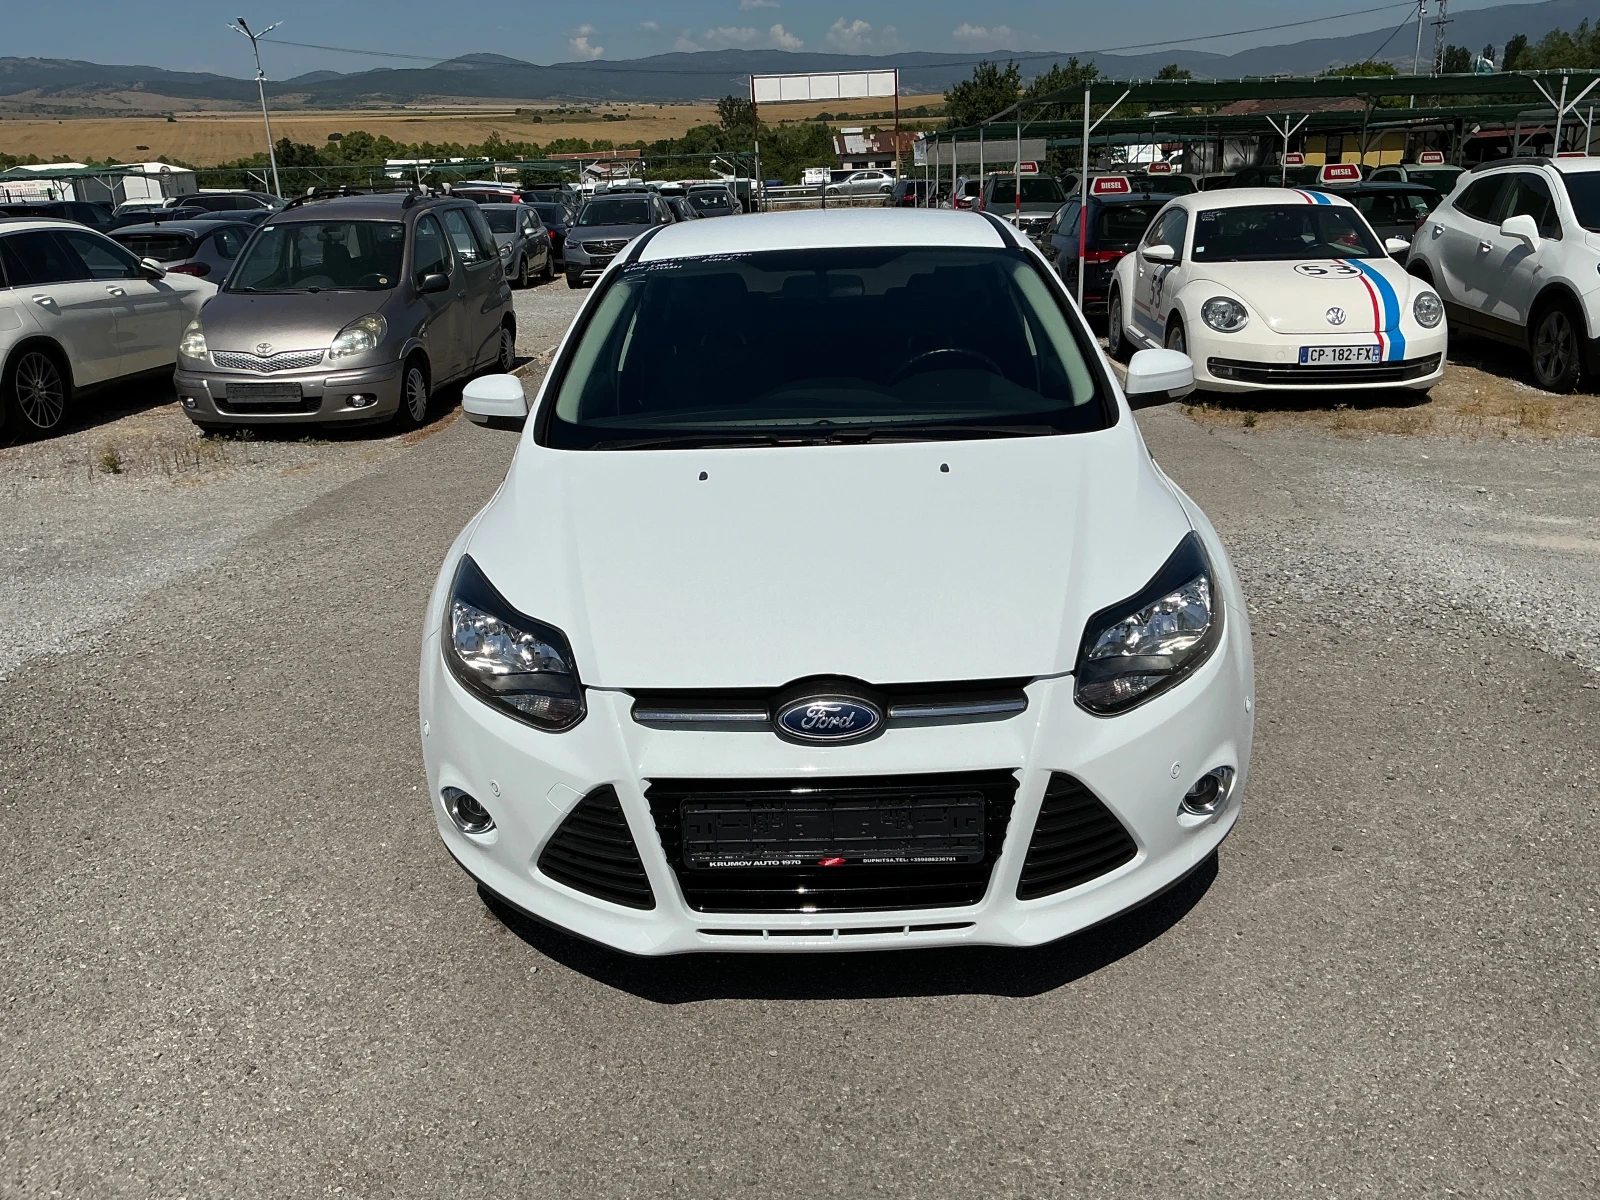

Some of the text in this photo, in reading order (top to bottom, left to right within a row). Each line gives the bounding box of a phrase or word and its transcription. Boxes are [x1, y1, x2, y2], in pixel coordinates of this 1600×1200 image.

[1330, 168, 1352, 176] DIESEL
[1100, 181, 1122, 190] DIESEL
[1300, 264, 1358, 275] 53
[1149, 274, 1163, 309] 53
[800, 705, 856, 729] Ford
